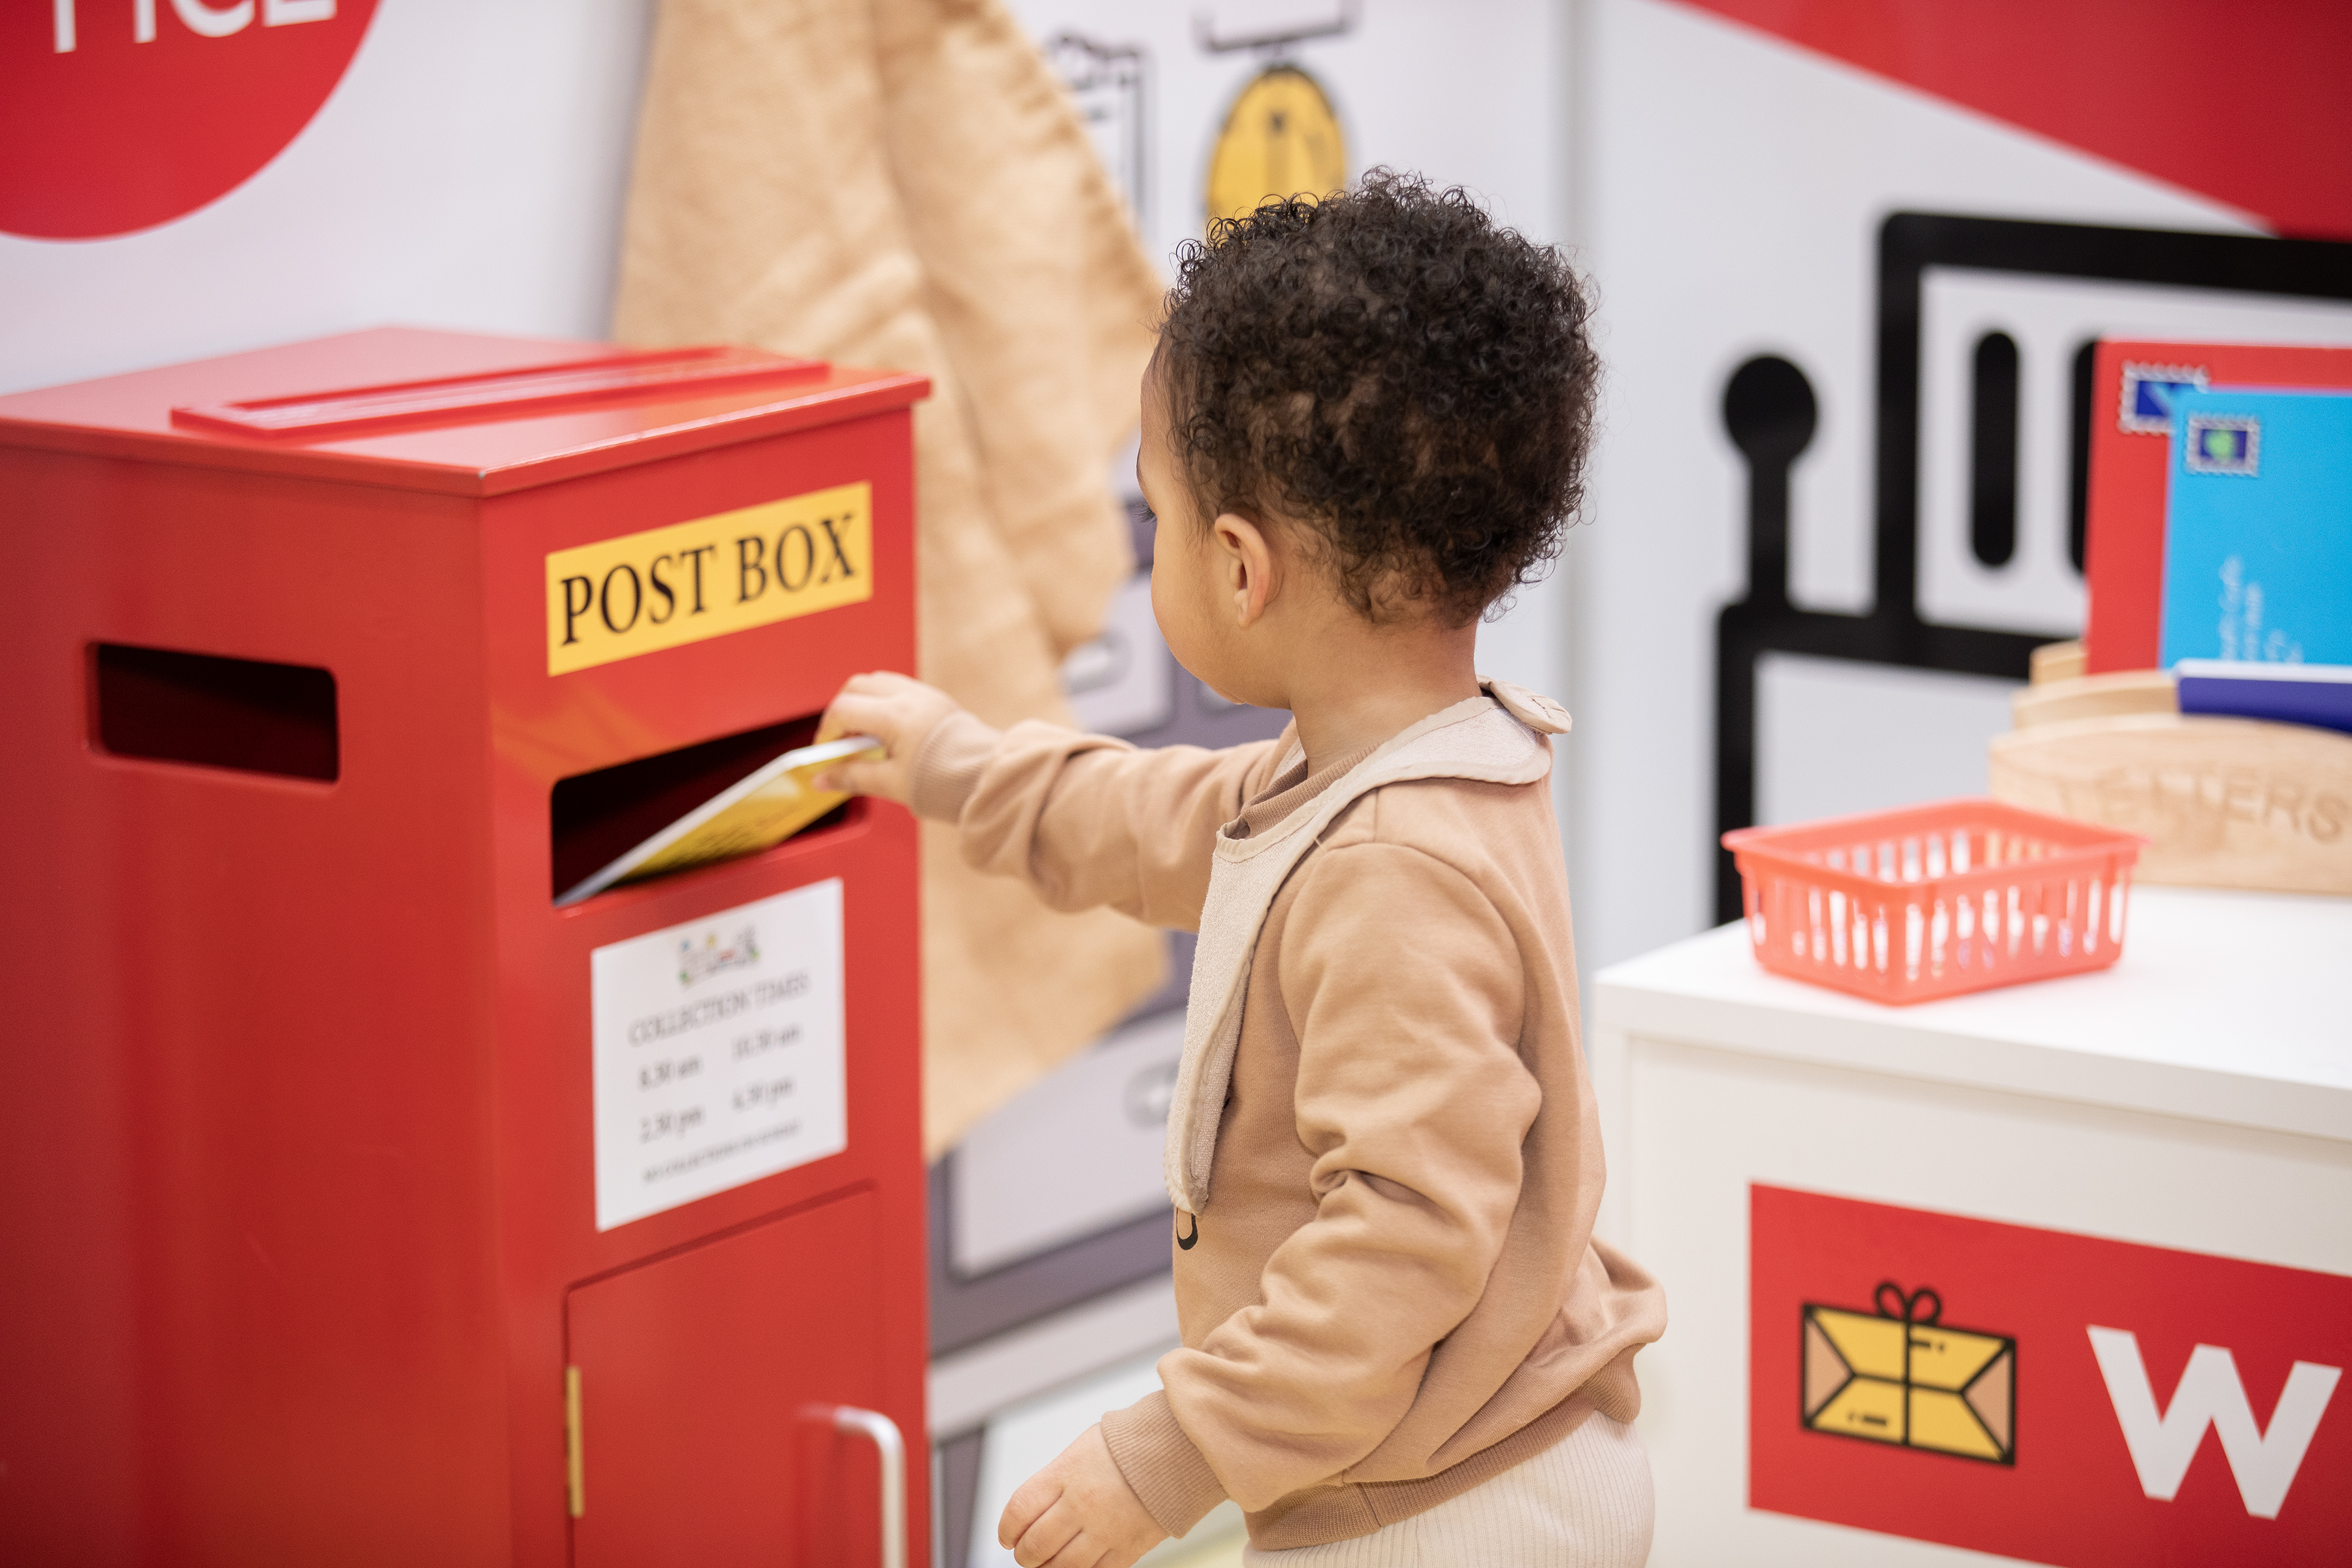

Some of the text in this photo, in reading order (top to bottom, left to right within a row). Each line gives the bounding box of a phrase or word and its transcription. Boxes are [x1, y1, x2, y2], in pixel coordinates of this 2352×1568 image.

[559, 512, 856, 646] POST BOX
[628, 970, 810, 1047] COLLECTION TIMES
[777, 1024, 801, 1047] am
[676, 1056, 703, 1079] am
[767, 1077, 794, 1107] pm
[638, 1105, 704, 1143] 2.30 pm
[2086, 1324, 2344, 1522] W
